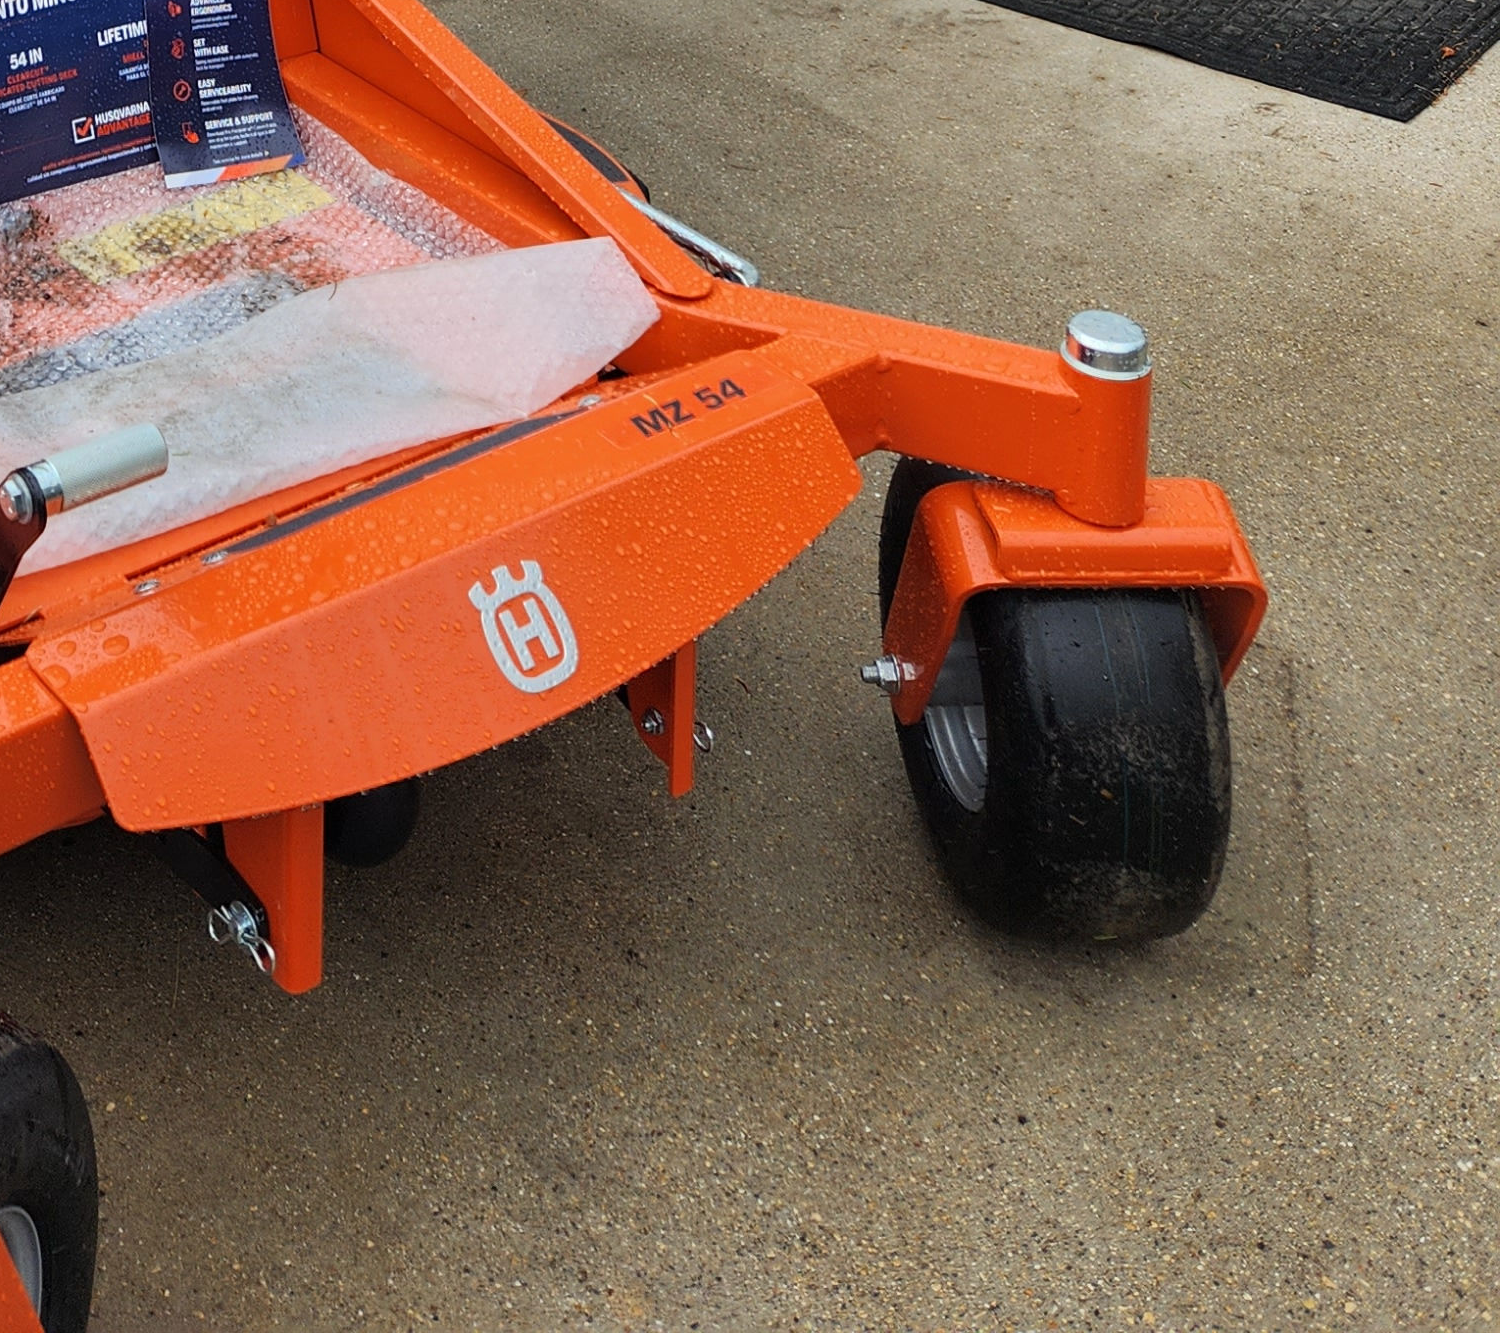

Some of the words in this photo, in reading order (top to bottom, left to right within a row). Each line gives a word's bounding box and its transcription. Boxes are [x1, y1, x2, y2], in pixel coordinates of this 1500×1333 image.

[190, 3, 233, 17] ERGONOMICS
[193, 37, 206, 48] SET
[193, 47, 212, 58] WITH
[212, 44, 230, 56] EASE
[9, 49, 28, 70] 54
[29, 46, 44, 67] IN
[26, 73, 54, 92] CUTTING
[54, 68, 79, 84] DECK
[197, 77, 217, 89] EASY
[198, 83, 252, 99] SERVICEABILITY
[94, 100, 151, 126] HUSQVARNA
[204, 117, 234, 131] SERVICE
[241, 111, 274, 124] SUPPORT
[96, 112, 151, 137] ADVANTAGE
[629, 398, 696, 438] MZ
[693, 378, 748, 410] 54
